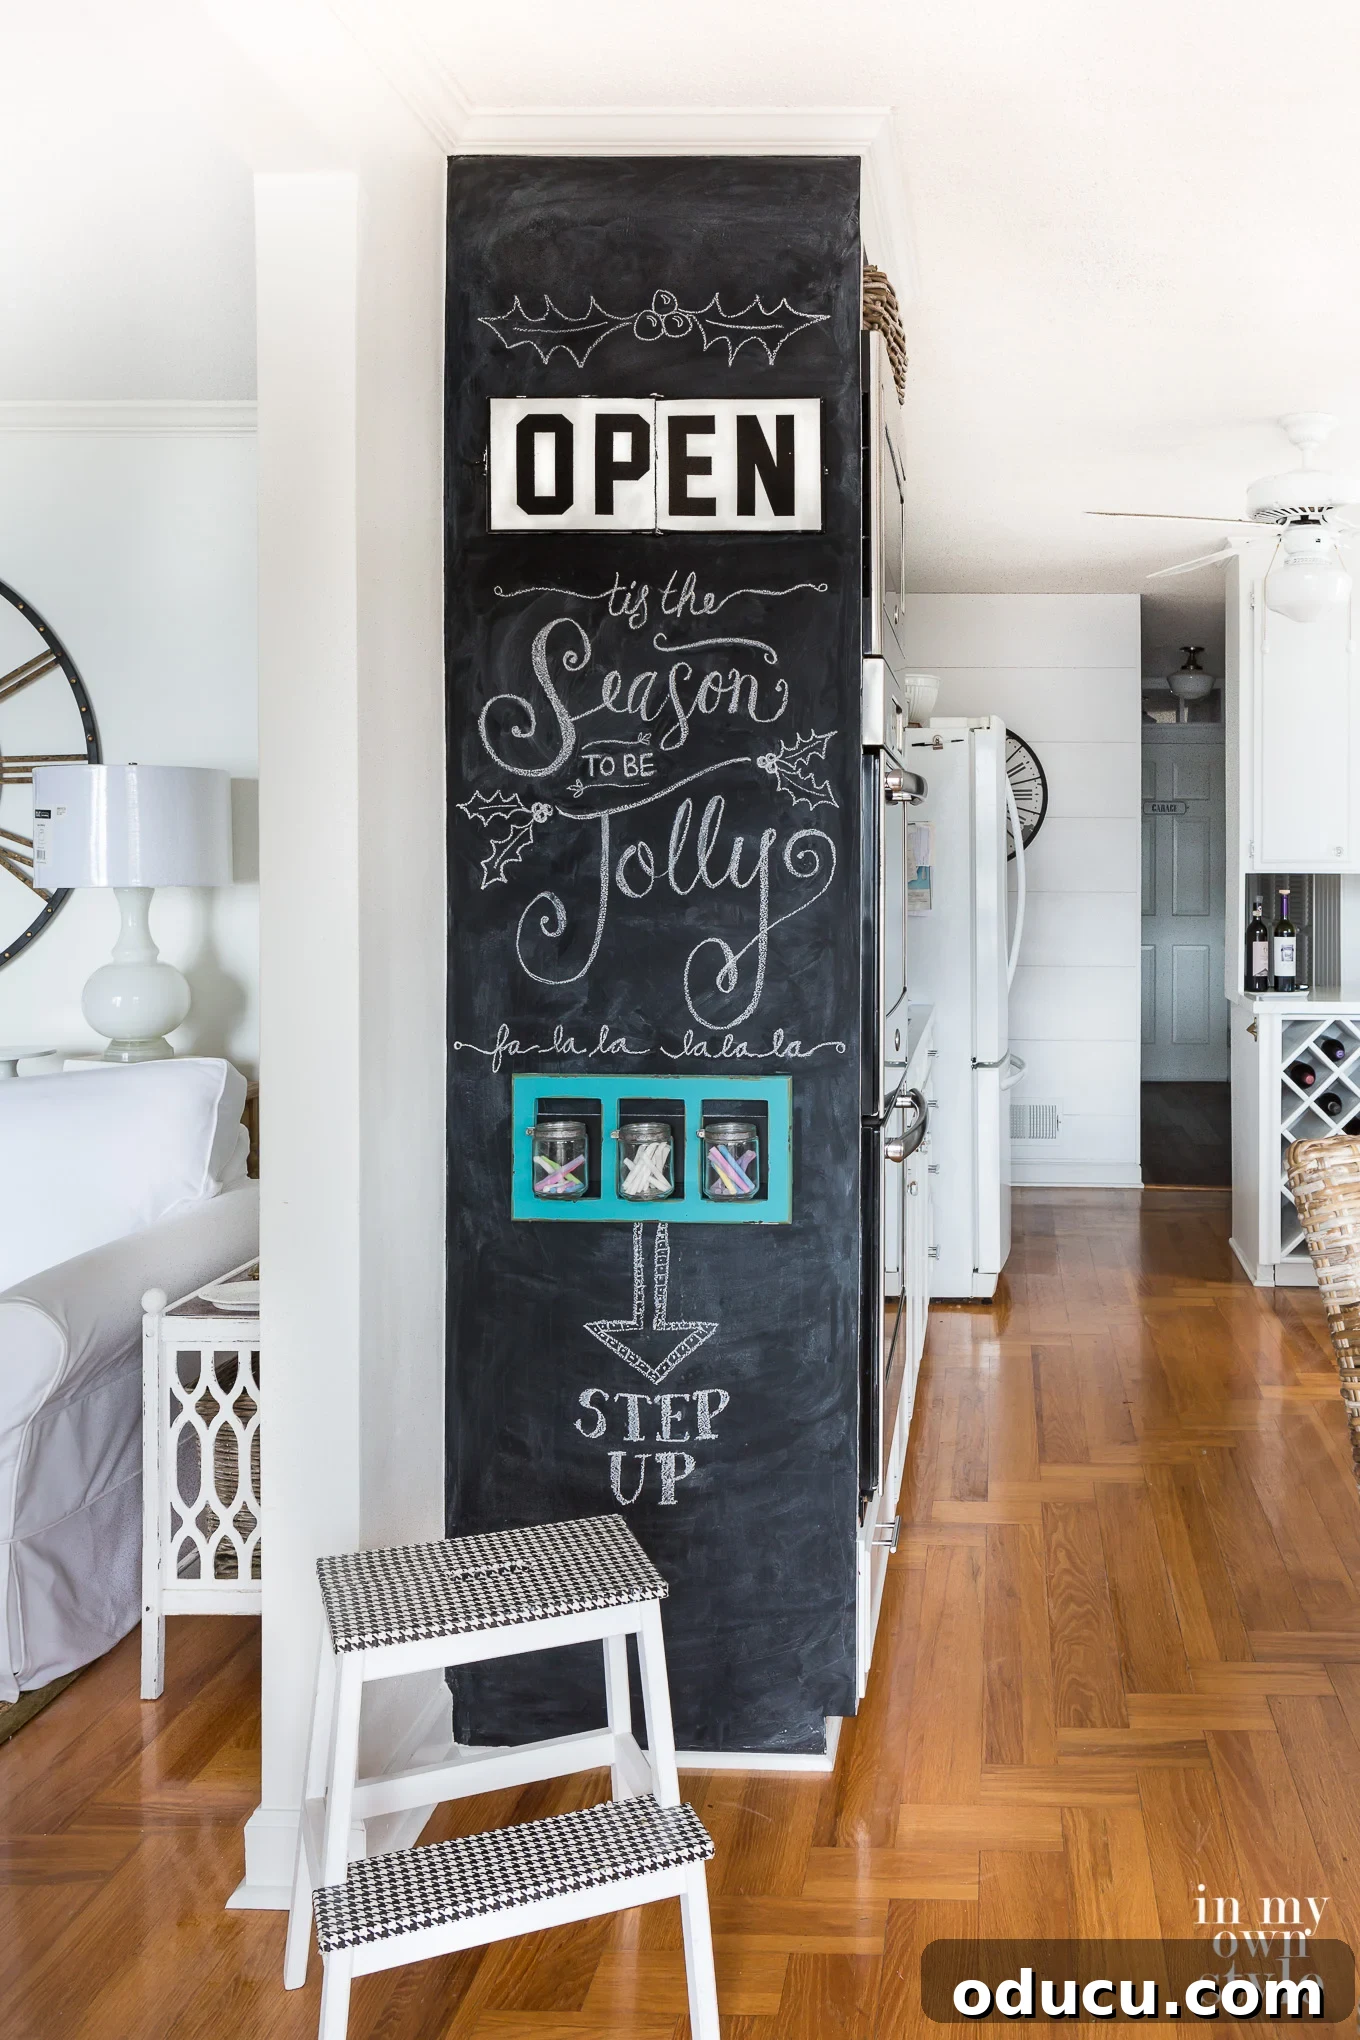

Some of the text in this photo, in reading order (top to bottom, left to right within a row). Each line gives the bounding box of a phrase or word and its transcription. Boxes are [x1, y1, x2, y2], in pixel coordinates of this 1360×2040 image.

[516, 413, 795, 517] OPEN
[659, 570, 722, 618] the
[478, 617, 789, 778] Season
[582, 752, 657, 777] TO BE
[1151, 803, 1178, 813] GARAGE
[516, 795, 837, 1030] Jolly
[490, 1023, 811, 1072] fa la la la la la
[573, 1387, 731, 1442] STEP
[607, 1451, 697, 1506] UP
